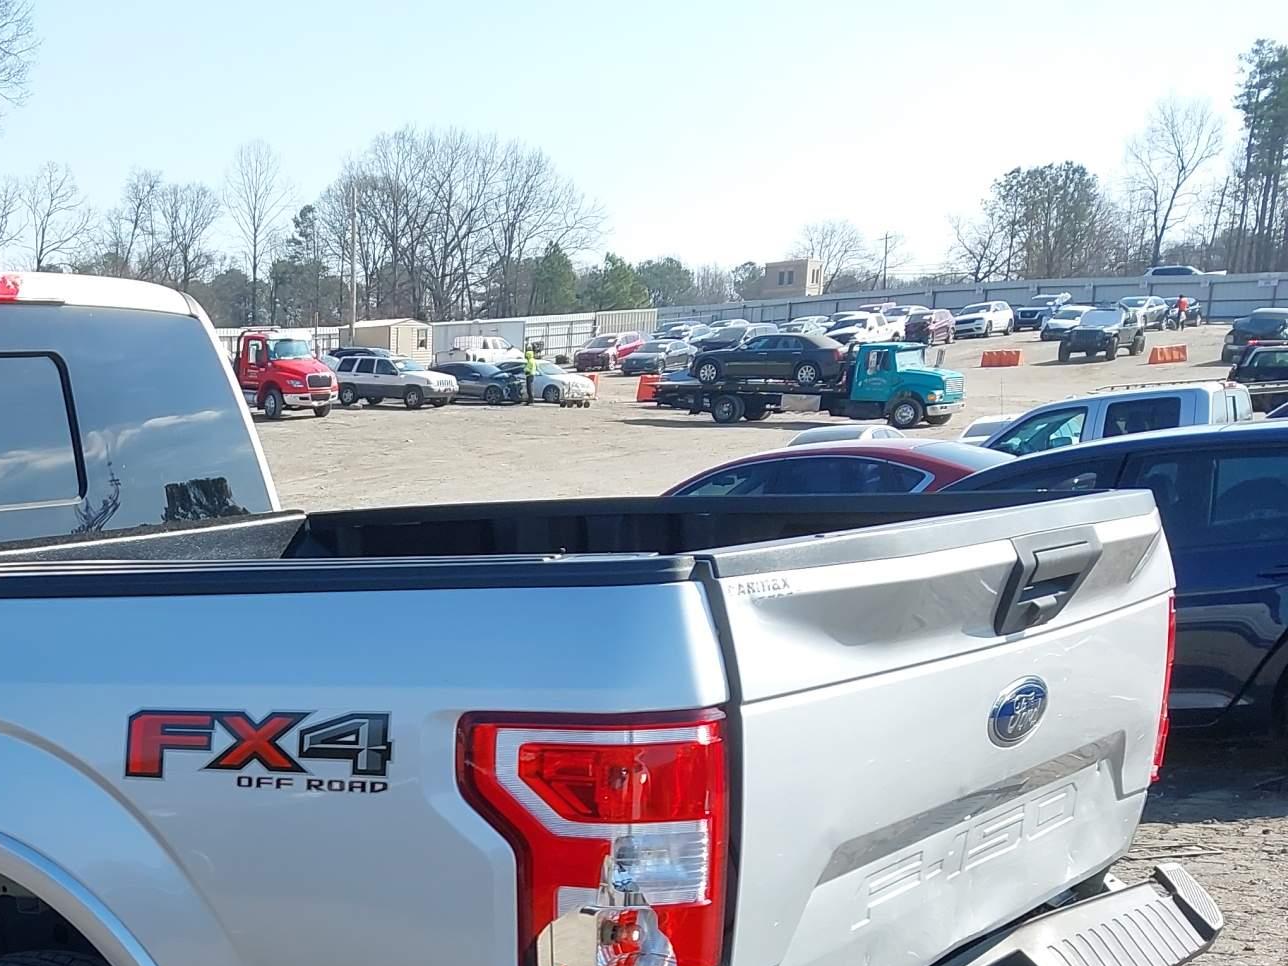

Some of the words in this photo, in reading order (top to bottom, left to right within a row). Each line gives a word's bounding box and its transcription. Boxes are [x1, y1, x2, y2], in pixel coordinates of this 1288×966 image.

[125, 710, 393, 778] FX4
[236, 775, 295, 789] OFF
[306, 778, 388, 794] ROAD
[850, 782, 1078, 931] F-150
